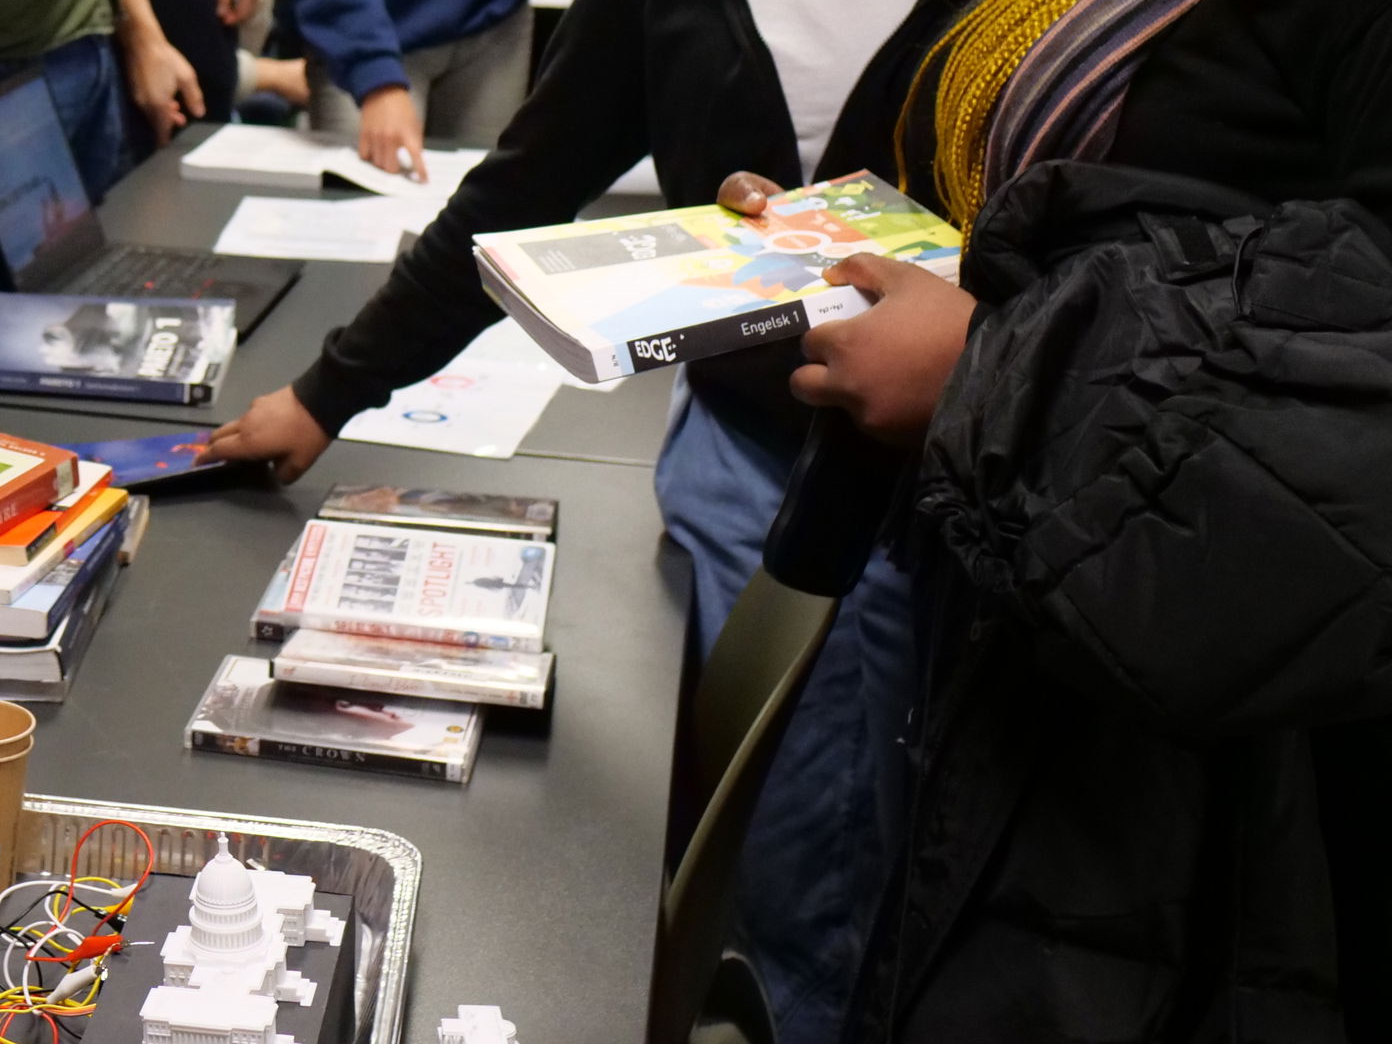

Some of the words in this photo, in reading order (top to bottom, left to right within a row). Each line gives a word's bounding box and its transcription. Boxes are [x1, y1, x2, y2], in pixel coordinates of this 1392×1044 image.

[740, 313, 791, 337] Engelsk
[792, 310, 801, 324] 1
[634, 336, 677, 363] EDGE
[417, 542, 456, 617] SPOTLIGHT
[301, 744, 366, 763] CROWN
